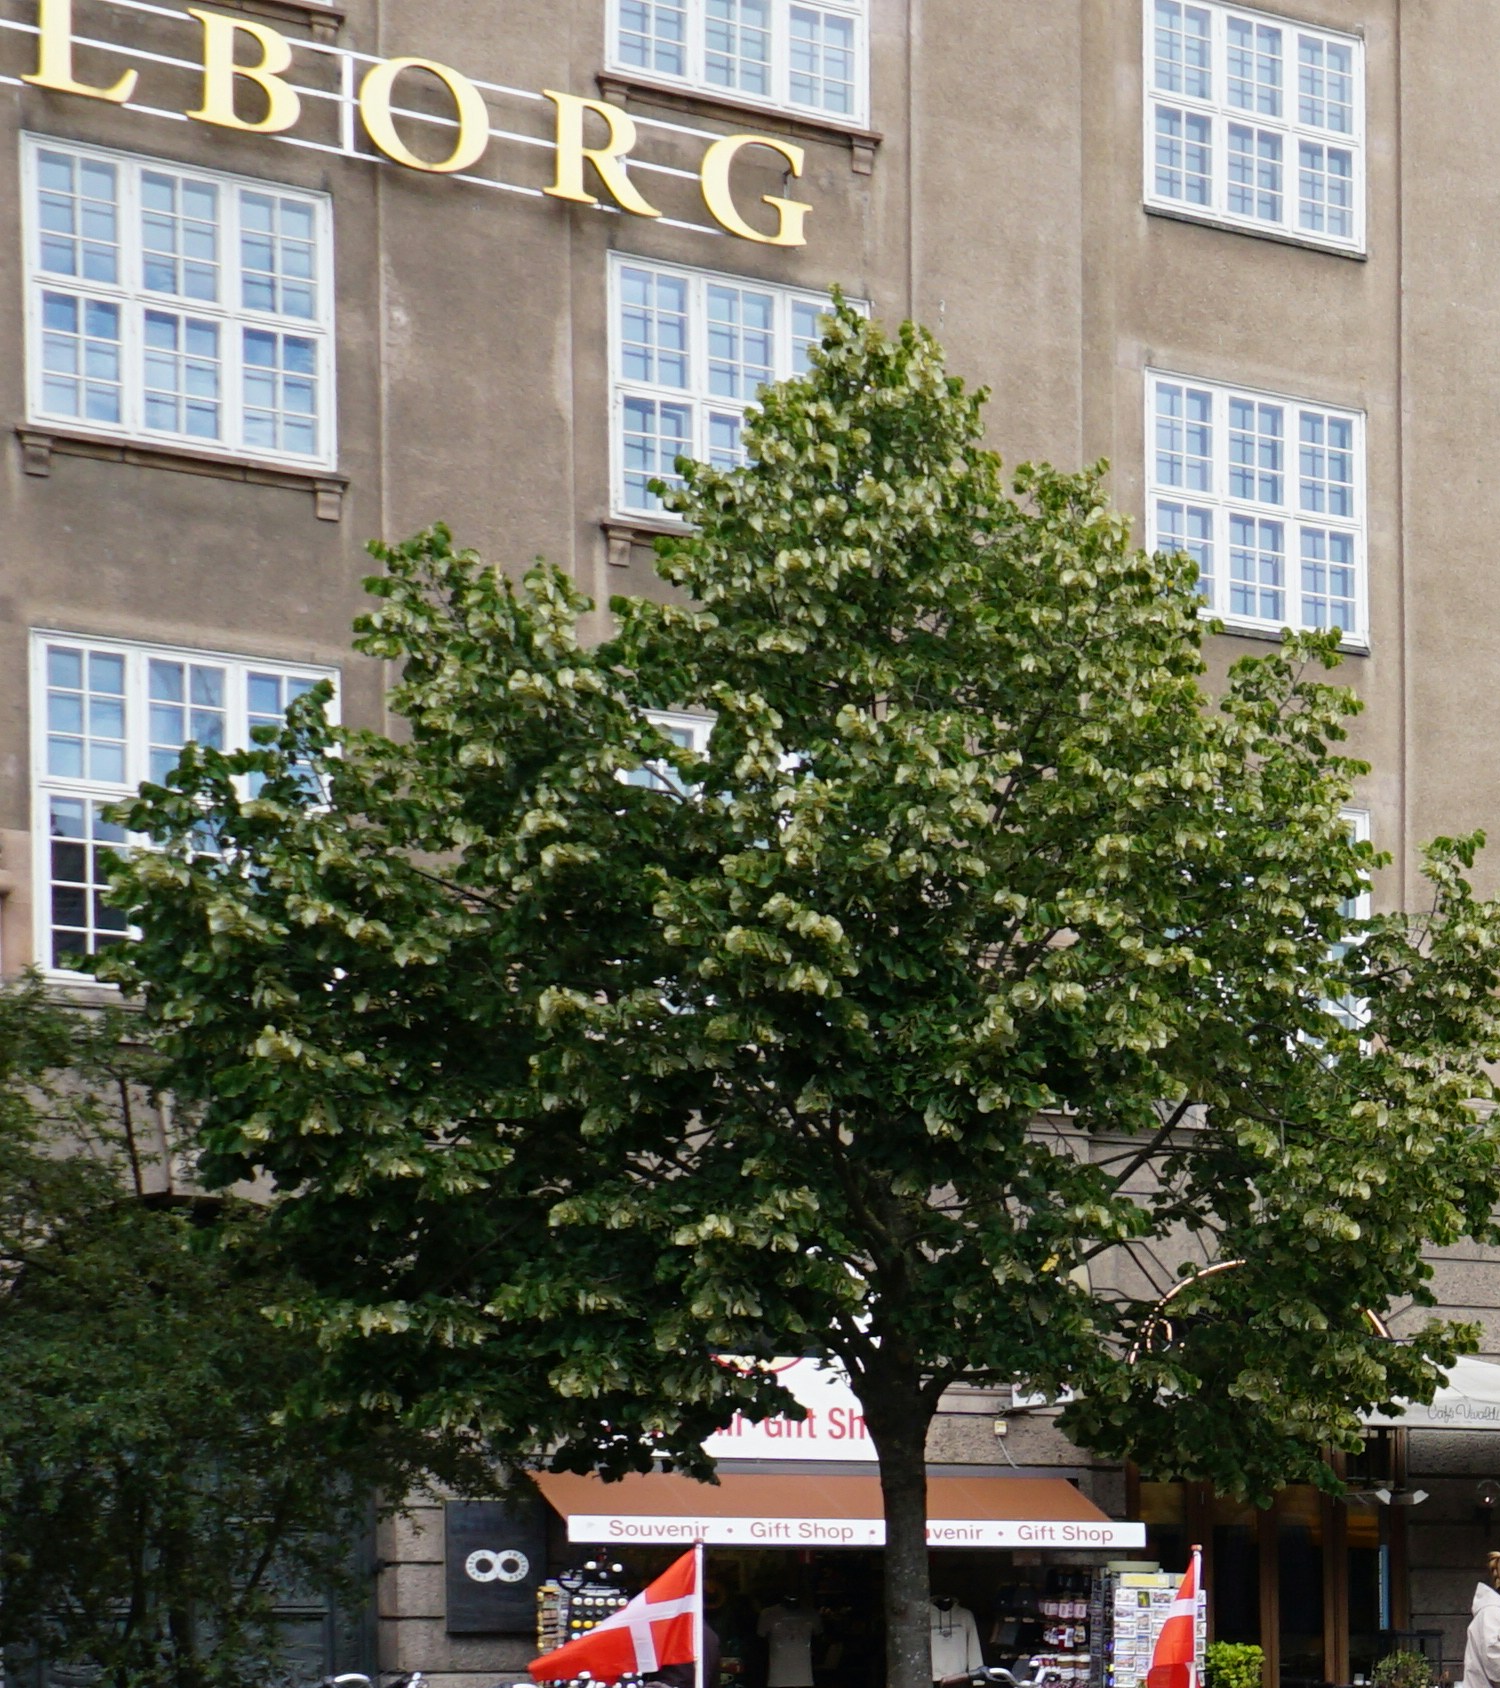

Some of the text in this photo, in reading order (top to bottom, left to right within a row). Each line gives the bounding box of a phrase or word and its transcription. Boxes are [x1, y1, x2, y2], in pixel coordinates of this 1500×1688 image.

[21, 0, 814, 247] LBORG
[609, 1520, 854, 1542] Souvenir Gift Shop
[1018, 1525, 1055, 1541] Gift
[1062, 1526, 1114, 1545] Shop
